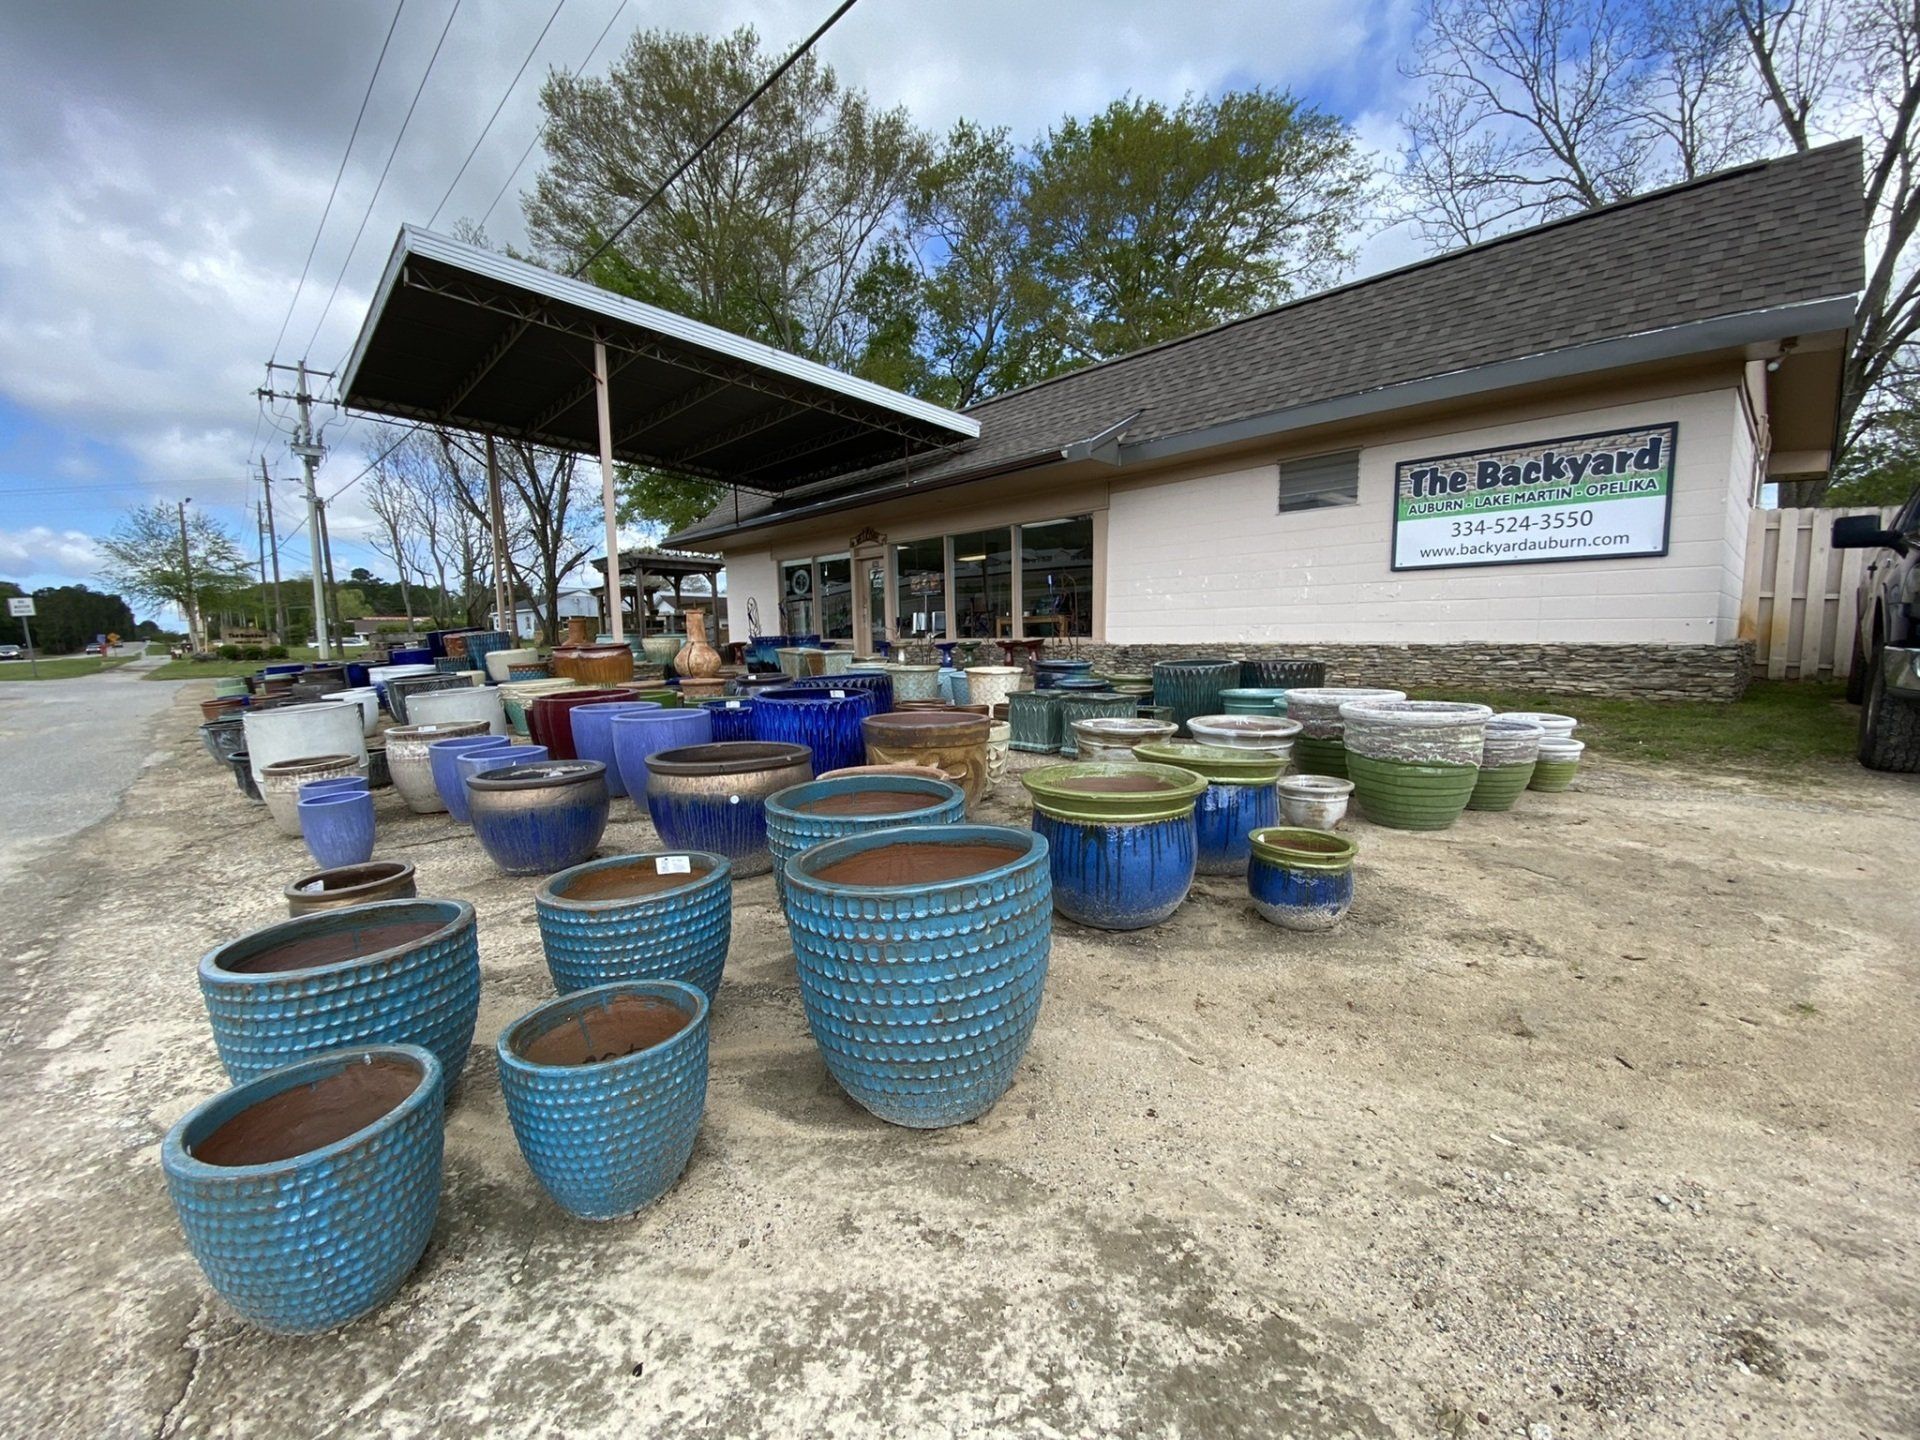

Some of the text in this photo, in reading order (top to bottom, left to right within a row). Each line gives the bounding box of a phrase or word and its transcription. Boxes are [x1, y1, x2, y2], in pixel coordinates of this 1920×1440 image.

[1409, 437, 1662, 497] The Backyard
[1408, 501, 1463, 515] AUBURN
[1475, 494, 1511, 508] LAKE
[1514, 488, 1573, 504] MARTIN
[1586, 478, 1658, 496] OPELIKA
[1451, 509, 1593, 538] 334-524-3550
[1420, 534, 1630, 558] www.backyardauburn.com
